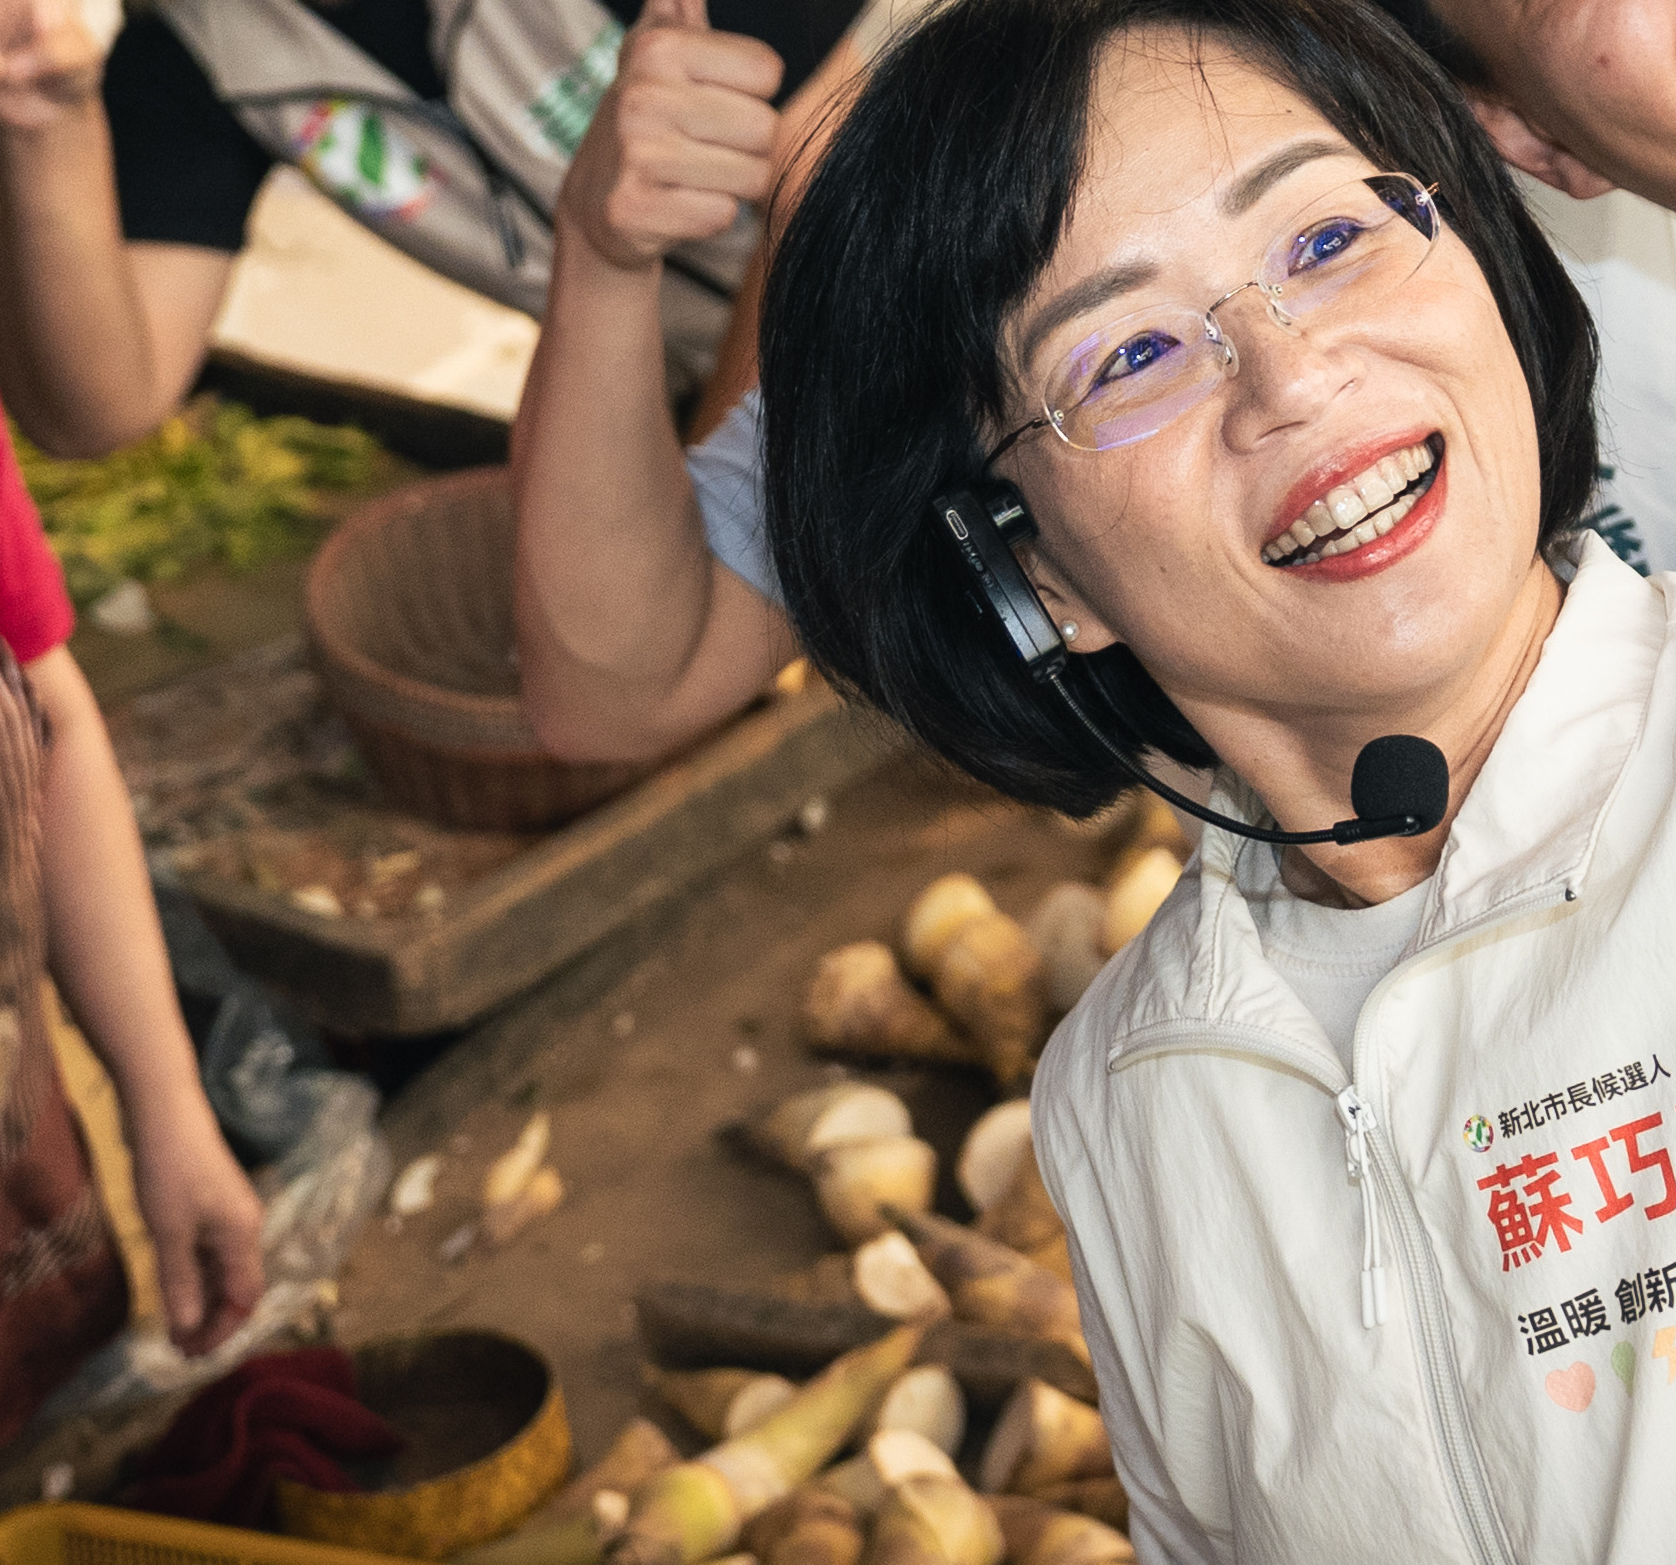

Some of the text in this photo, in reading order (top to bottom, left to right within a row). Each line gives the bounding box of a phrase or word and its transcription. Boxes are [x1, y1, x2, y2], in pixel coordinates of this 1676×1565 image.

[1498, 1053, 1672, 1139] 新北市長候選人
[1517, 1287, 1612, 1356] 溫暖
